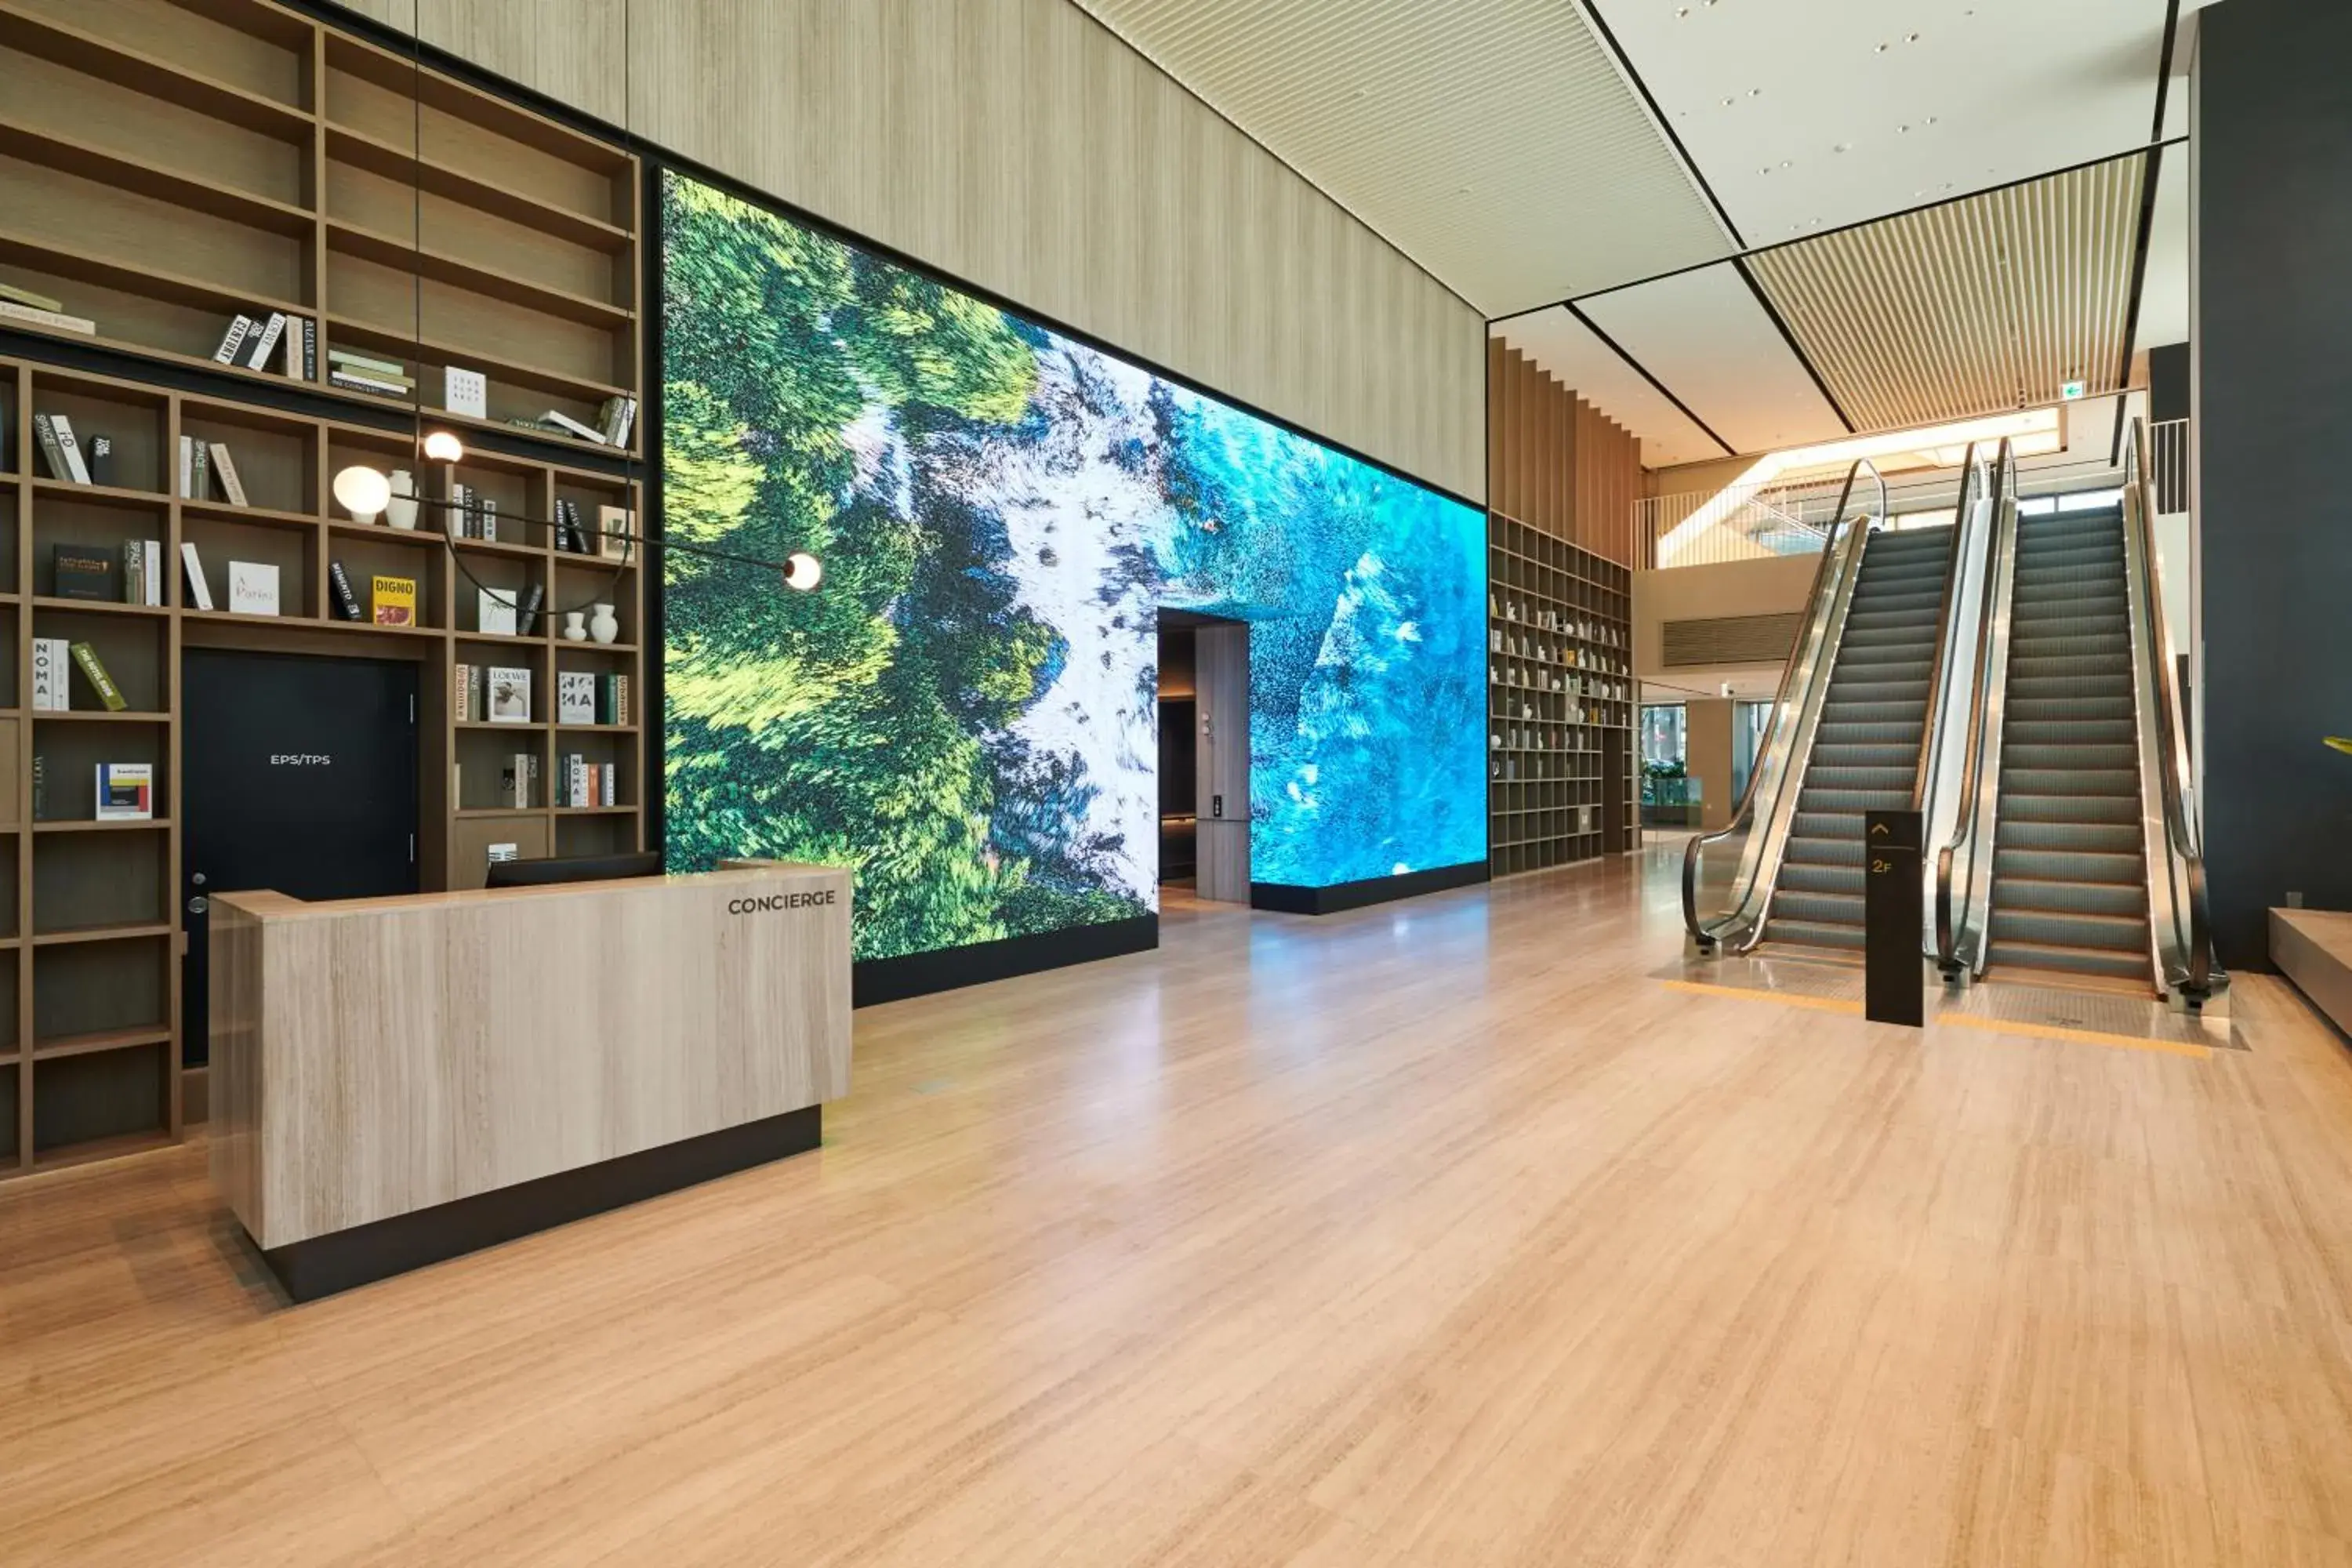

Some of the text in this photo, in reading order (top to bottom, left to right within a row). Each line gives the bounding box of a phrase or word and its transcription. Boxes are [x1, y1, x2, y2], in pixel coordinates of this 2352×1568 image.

[35, 644, 48, 695] NOMA
[270, 753, 330, 766] EPS/TPS
[1871, 858, 1892, 874] 2F
[728, 890, 836, 915] CONCIERGE
